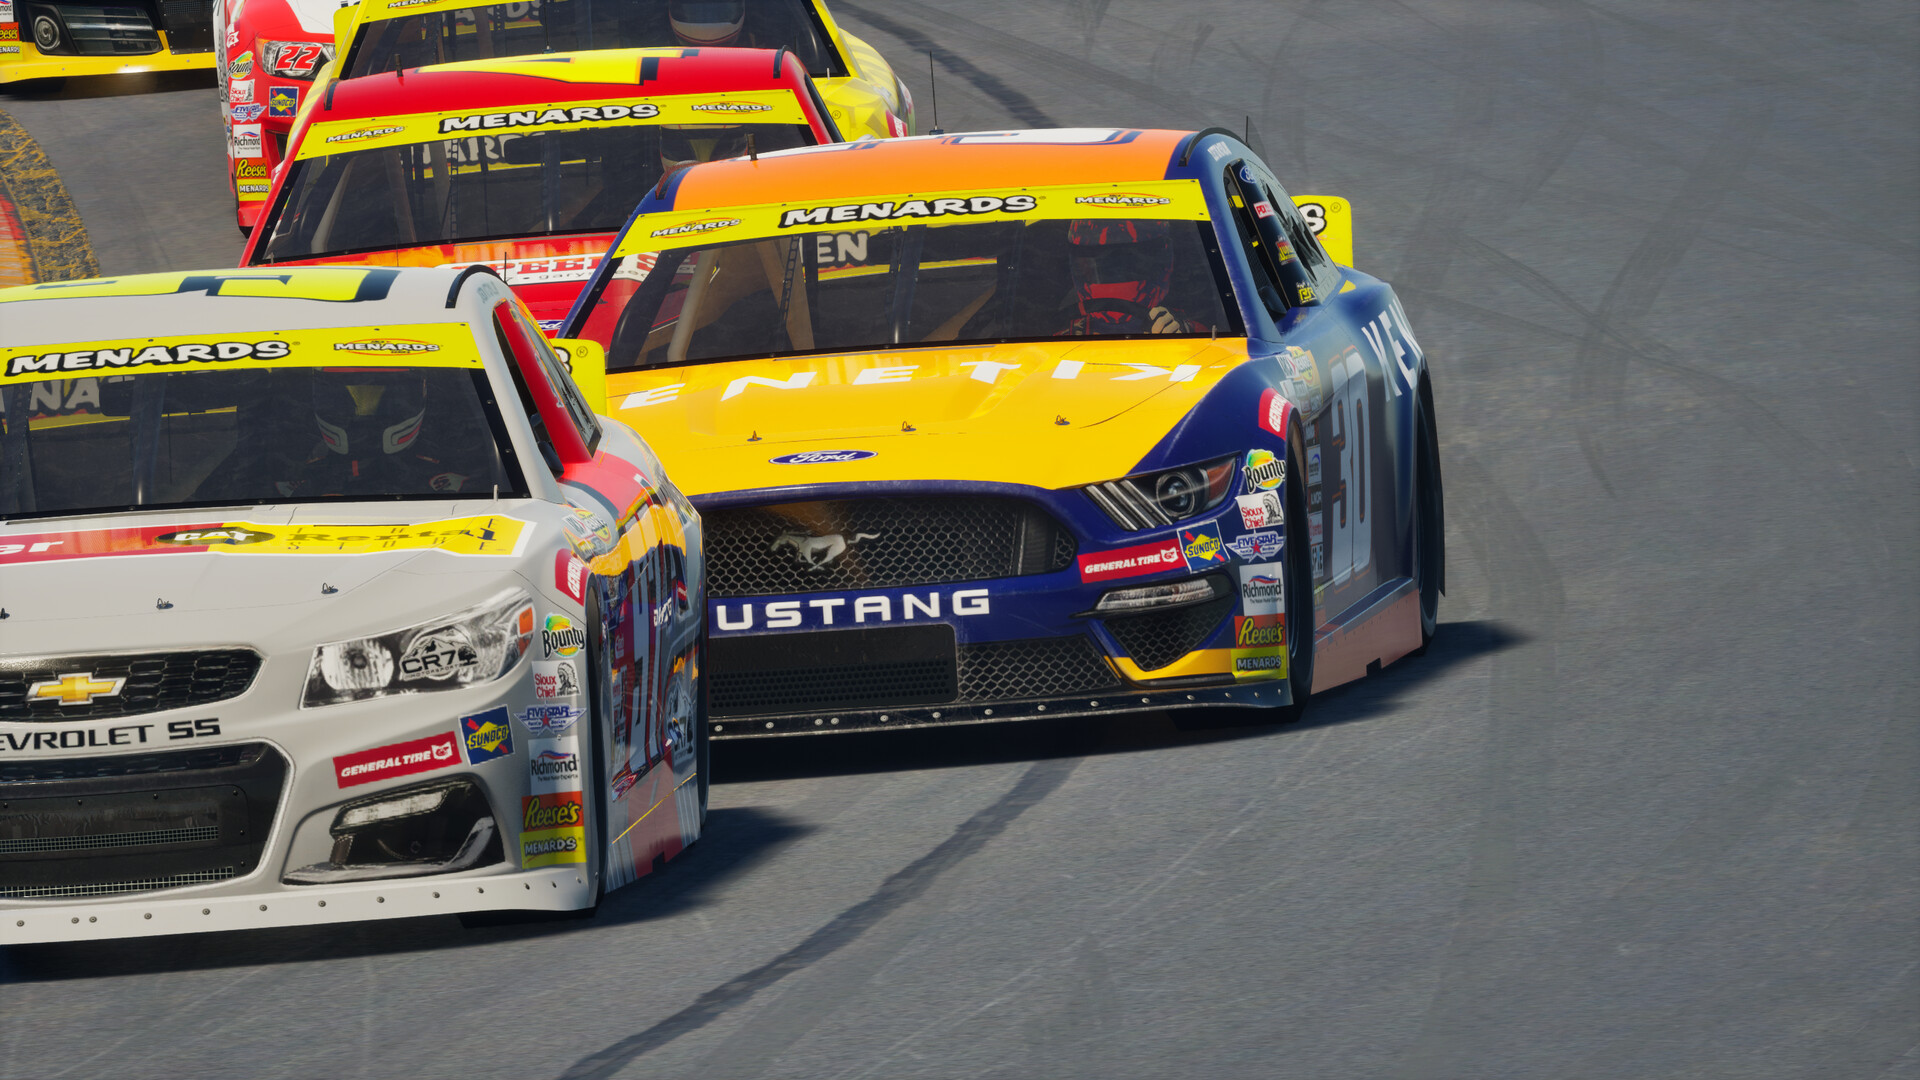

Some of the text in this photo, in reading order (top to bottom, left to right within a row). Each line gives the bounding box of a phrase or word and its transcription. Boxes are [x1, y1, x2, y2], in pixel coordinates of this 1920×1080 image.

[275, 46, 322, 70] 22
[271, 98, 296, 107] SUNOCO
[692, 103, 773, 112] MENARDS
[439, 104, 660, 133] MENARDS
[234, 136, 260, 146] Richmond
[326, 126, 405, 143] MENARDS
[237, 159, 267, 178] Reese's
[239, 185, 269, 193] MENARDS
[779, 195, 1038, 228] MENARDS
[651, 218, 742, 238] MENARDS
[334, 343, 440, 351] MENARDS
[5, 340, 290, 376] MENARDS
[619, 359, 1202, 411] ENETIK
[788, 451, 856, 464] Ford
[1245, 459, 1286, 493] Bounty
[1242, 507, 1265, 518] Sioux
[1245, 517, 1266, 529] Chief
[174, 531, 255, 542] CAT
[1187, 540, 1219, 556] SUNOCO
[1085, 554, 1161, 574] GENERAL TIRE
[1243, 579, 1282, 598] Richmond
[716, 588, 990, 631] USTANG
[1238, 617, 1285, 646] Reese's
[542, 627, 585, 659] Bounty
[402, 649, 457, 674] CR7
[1236, 656, 1282, 670] MENARDS
[535, 673, 556, 685] Sioux
[536, 686, 556, 698] Chief
[547, 706, 569, 717] STAR
[0, 718, 221, 750] VROLET SS
[469, 726, 508, 748] SUNOCO
[341, 750, 432, 777] GENERAL TIRE
[531, 753, 577, 776] Richmond
[524, 796, 581, 830] Reese's
[524, 837, 577, 856] MENARDS
